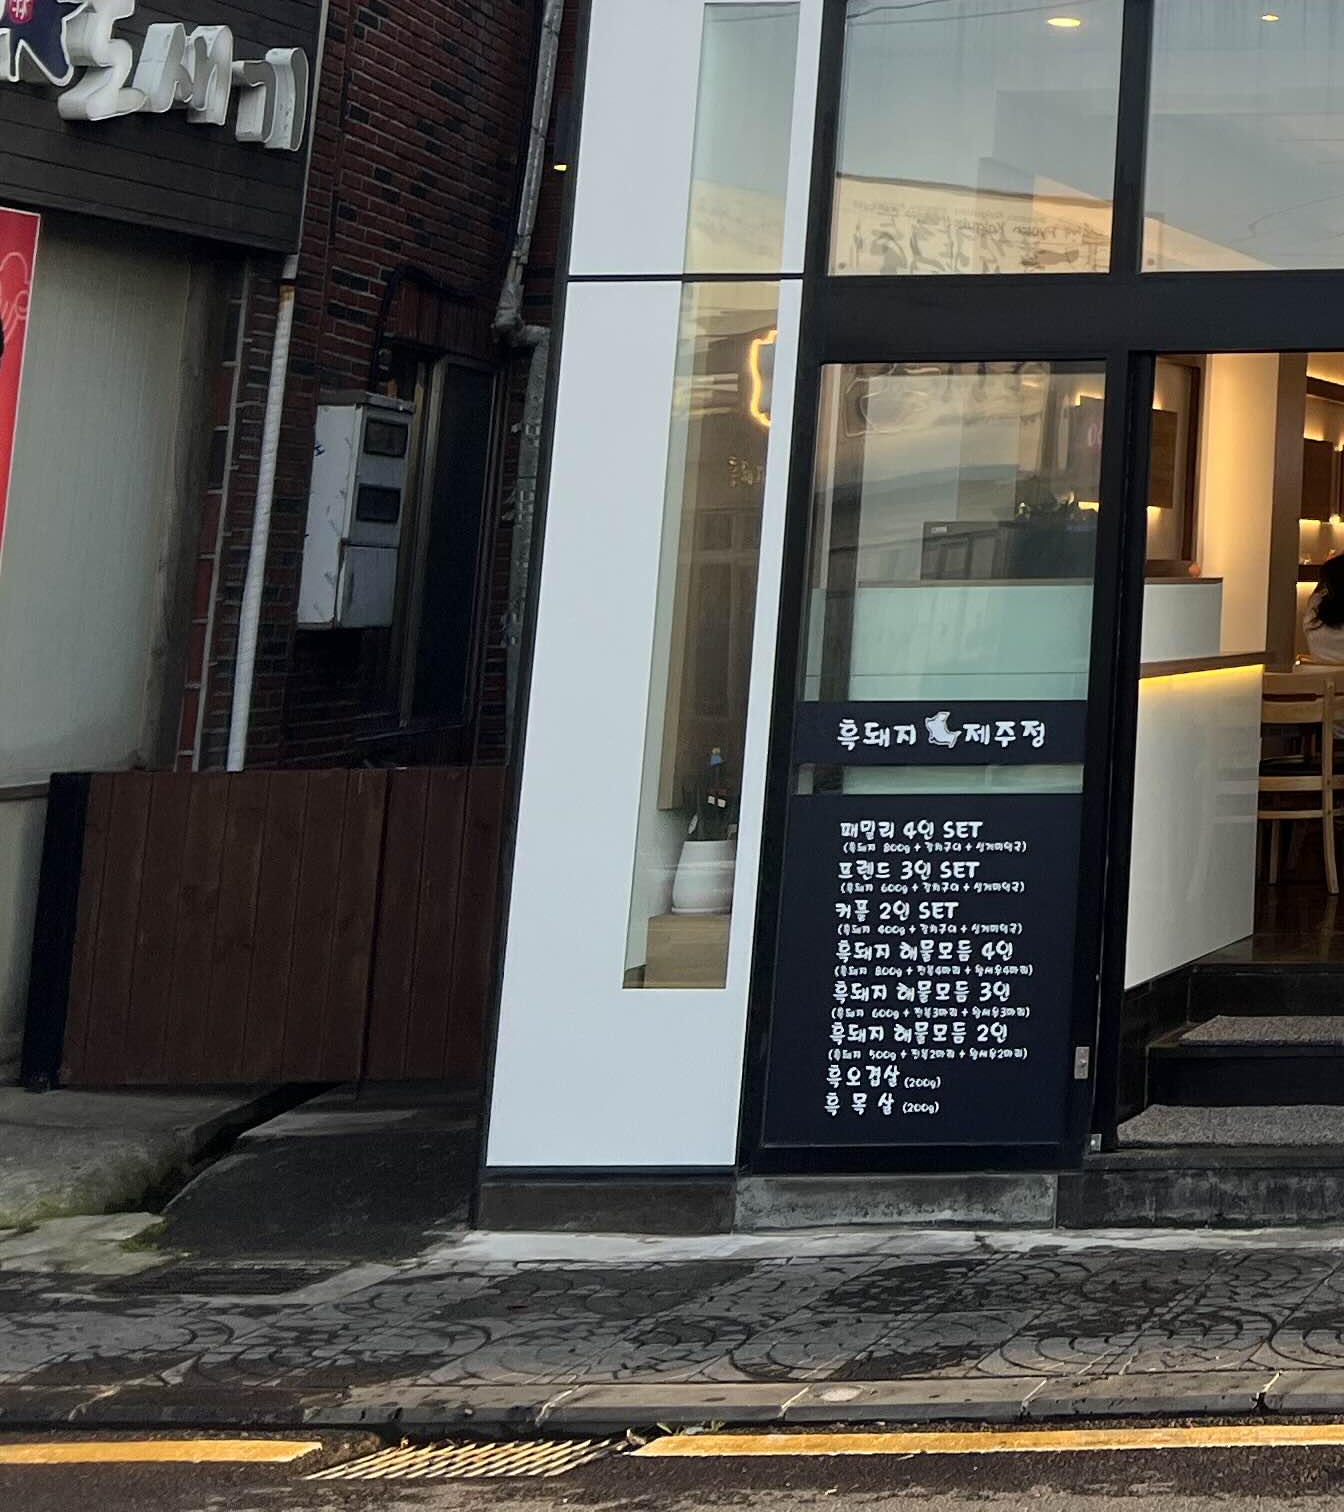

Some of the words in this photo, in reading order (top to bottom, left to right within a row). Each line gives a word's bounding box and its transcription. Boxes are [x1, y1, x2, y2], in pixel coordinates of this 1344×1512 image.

[837, 719, 917, 751] 흑돼지
[963, 720, 1045, 747] 제주정
[840, 820, 895, 841] 패밀리
[902, 819, 935, 841] 4인
[942, 820, 984, 839] SET
[838, 859, 891, 881] 프렌드
[900, 859, 932, 881] 3인
[939, 860, 981, 879] SET
[835, 899, 871, 923] 커플
[879, 899, 910, 922] 2인
[918, 901, 960, 920] SET
[835, 939, 891, 964] 흑돼지
[899, 939, 973, 963] 해물모듬
[981, 939, 1013, 962] 4인
[832, 980, 888, 1005] 흑돼지
[895, 980, 970, 1004] 해물모듬
[979, 980, 1010, 1002] 3인
[829, 1021, 885, 1046] 흑돼지
[893, 1021, 967, 1045] 해물모듬
[976, 1021, 1008, 1044] 2인
[826, 1064, 901, 1089] 흑오겹살
[903, 1076, 941, 1090] (200g)
[824, 1092, 895, 1117] 흑목살
[902, 1101, 940, 1115] (200g)
